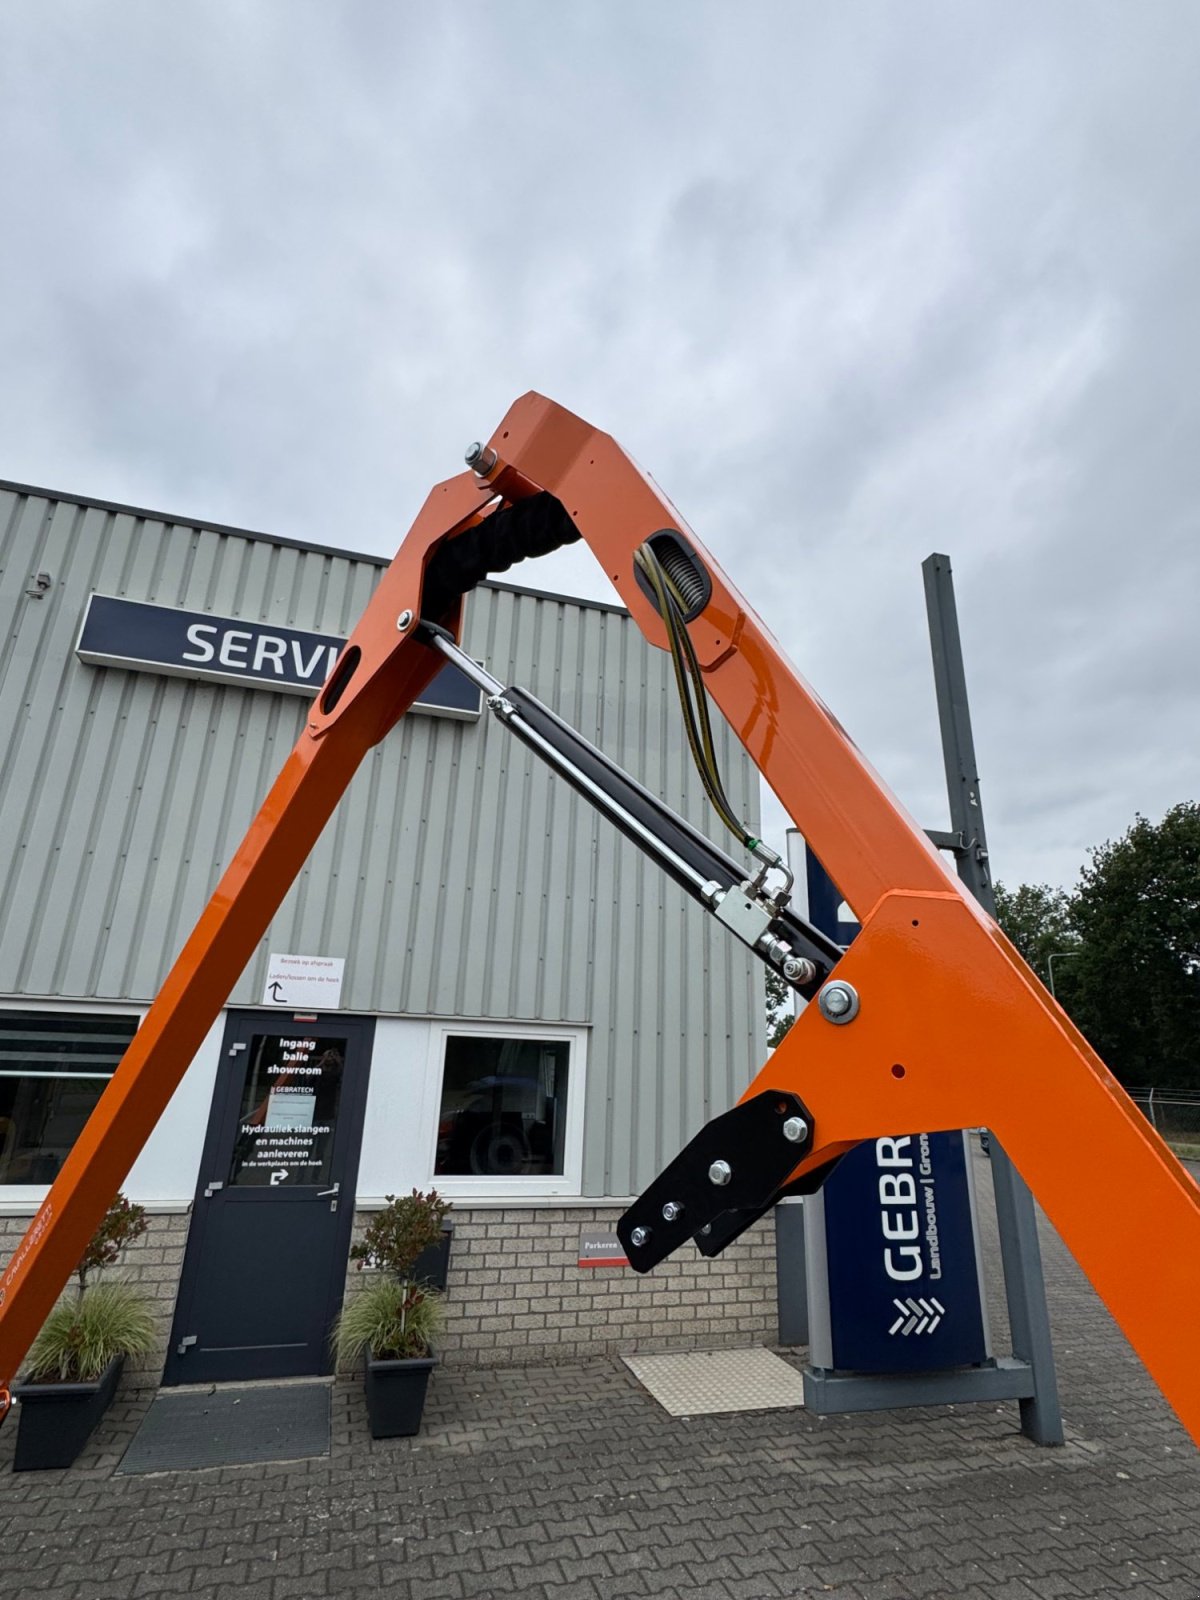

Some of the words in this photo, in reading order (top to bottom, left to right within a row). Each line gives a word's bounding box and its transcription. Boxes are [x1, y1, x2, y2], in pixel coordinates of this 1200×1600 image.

[182, 623, 338, 681] SERVI
[279, 1037, 316, 1051] Ingang
[282, 1051, 309, 1061] balie
[267, 1064, 322, 1075] showroom
[276, 1085, 314, 1093] GEBRATECH
[241, 1124, 292, 1135] Hydrauliek
[293, 1124, 330, 1135] slangen
[269, 1136, 314, 1146] machines
[257, 1148, 309, 1158] aanleveren
[257, 1160, 289, 1168] werkplaats
[875, 1135, 923, 1281] GEBR
[923, 1186, 942, 1280] Landbouw
[584, 1241, 618, 1249] Parkeren
